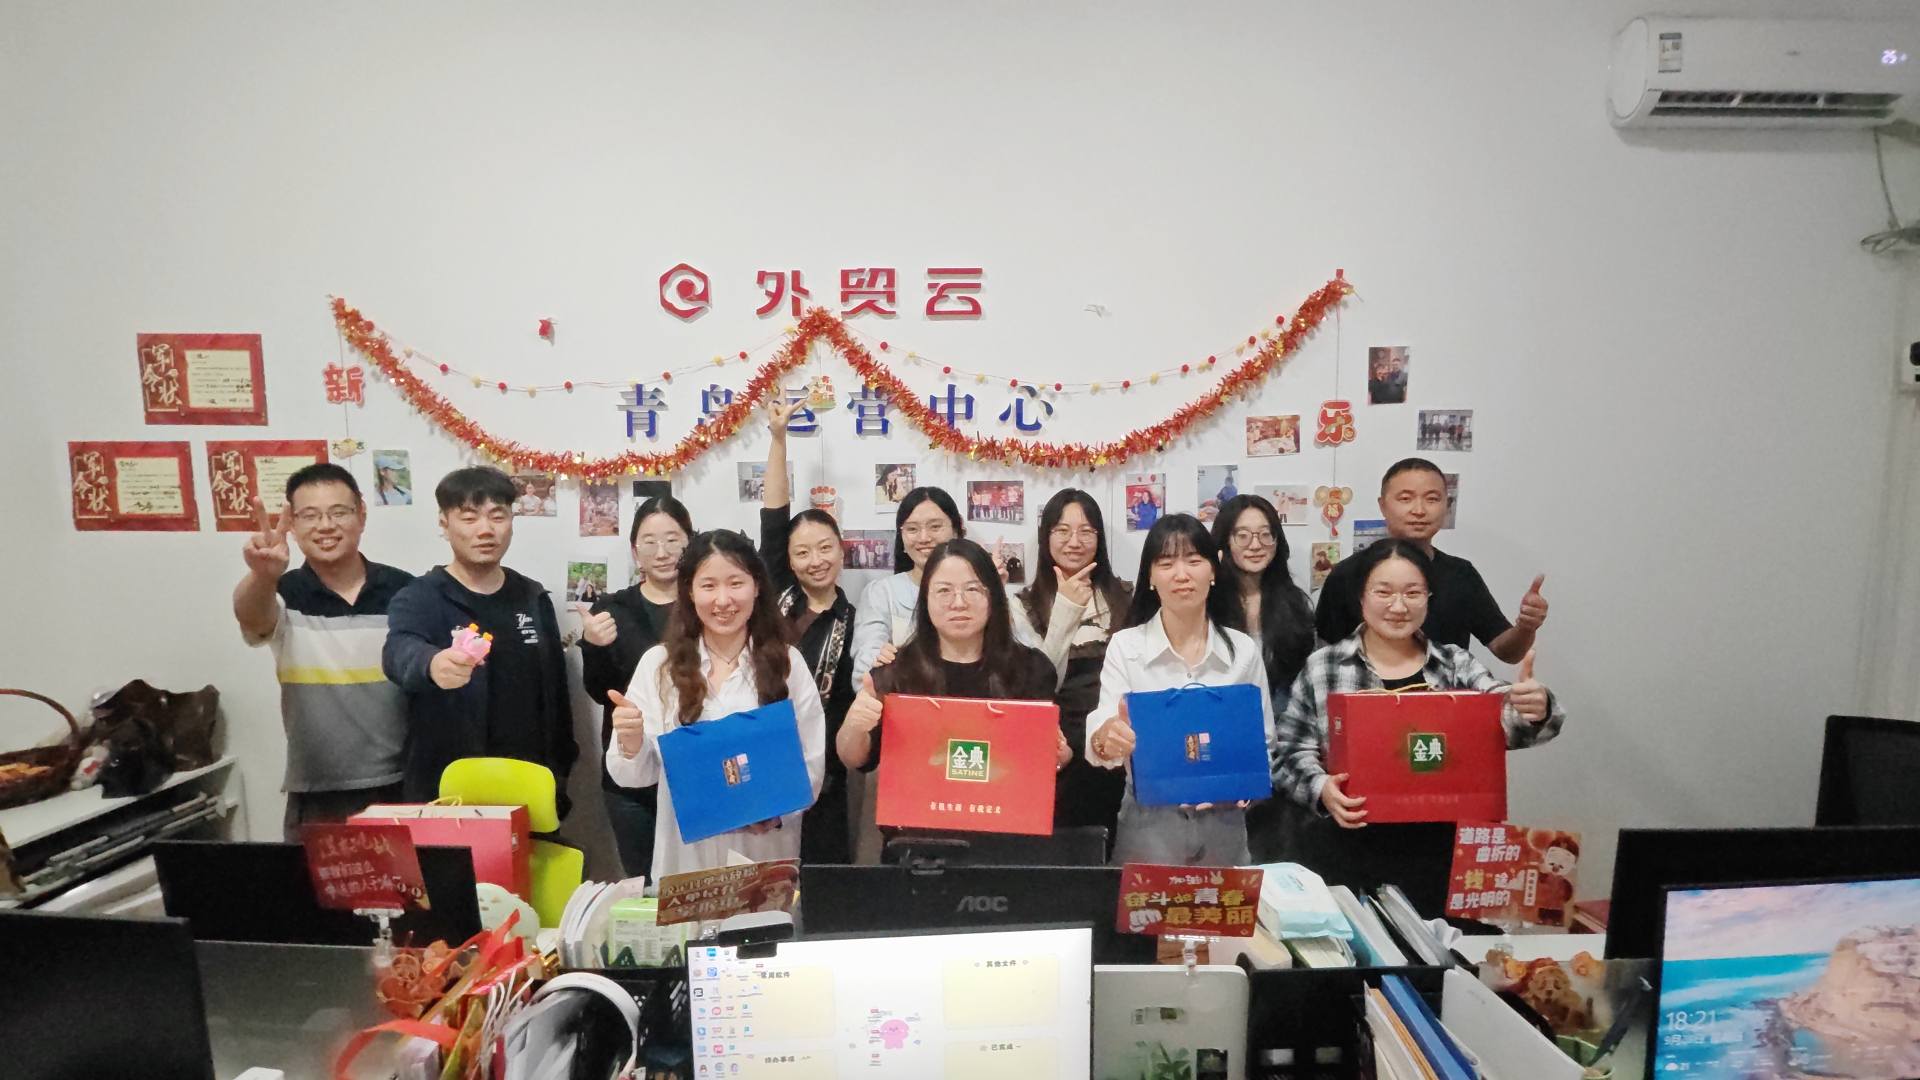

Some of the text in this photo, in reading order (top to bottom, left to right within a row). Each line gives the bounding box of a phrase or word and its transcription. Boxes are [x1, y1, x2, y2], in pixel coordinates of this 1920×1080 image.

[755, 267, 983, 317] 外贸云
[323, 363, 363, 403] 新
[952, 746, 984, 770] 金典
[1412, 738, 1443, 762] 金典
[951, 768, 985, 777] SATINE
[1459, 827, 1506, 844] 道路是
[1476, 845, 1520, 862] 曲折的
[956, 895, 1008, 912] AOC
[1123, 888, 1245, 908] 奋斗的青春
[1450, 891, 1510, 910] 是光明的
[1165, 906, 1254, 925] 最美丽
[1666, 1010, 1716, 1031] 18:21
